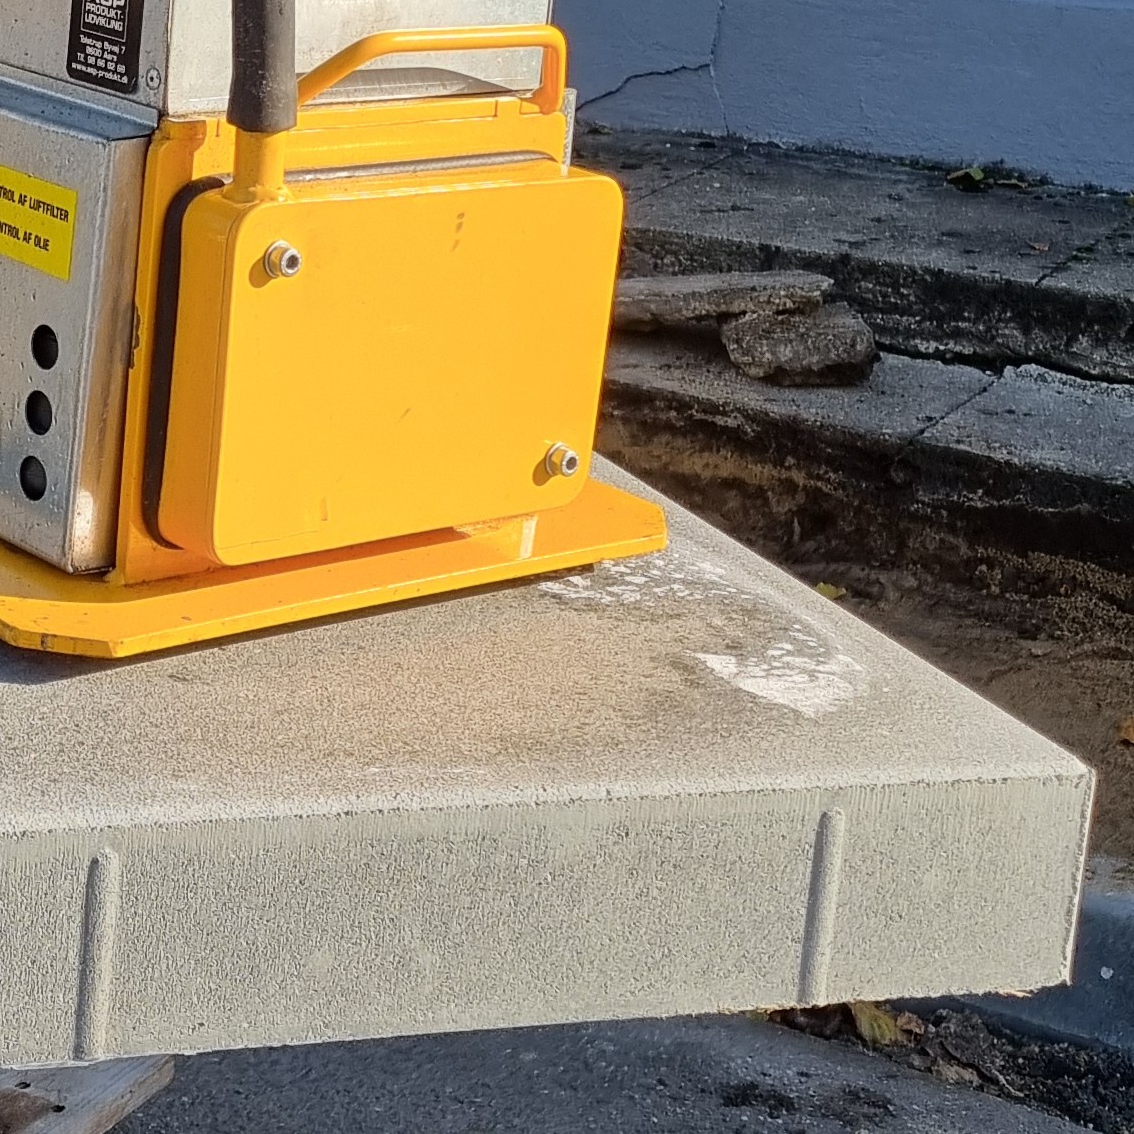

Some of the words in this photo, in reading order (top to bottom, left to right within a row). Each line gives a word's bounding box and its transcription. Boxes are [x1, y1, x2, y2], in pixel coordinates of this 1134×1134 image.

[84, 13, 124, 32] UDVIKLING
[17, 193, 28, 207] AF
[29, 196, 70, 223] LUFTFILTER
[22, 231, 33, 245] AF
[33, 234, 50, 252] OLIE
